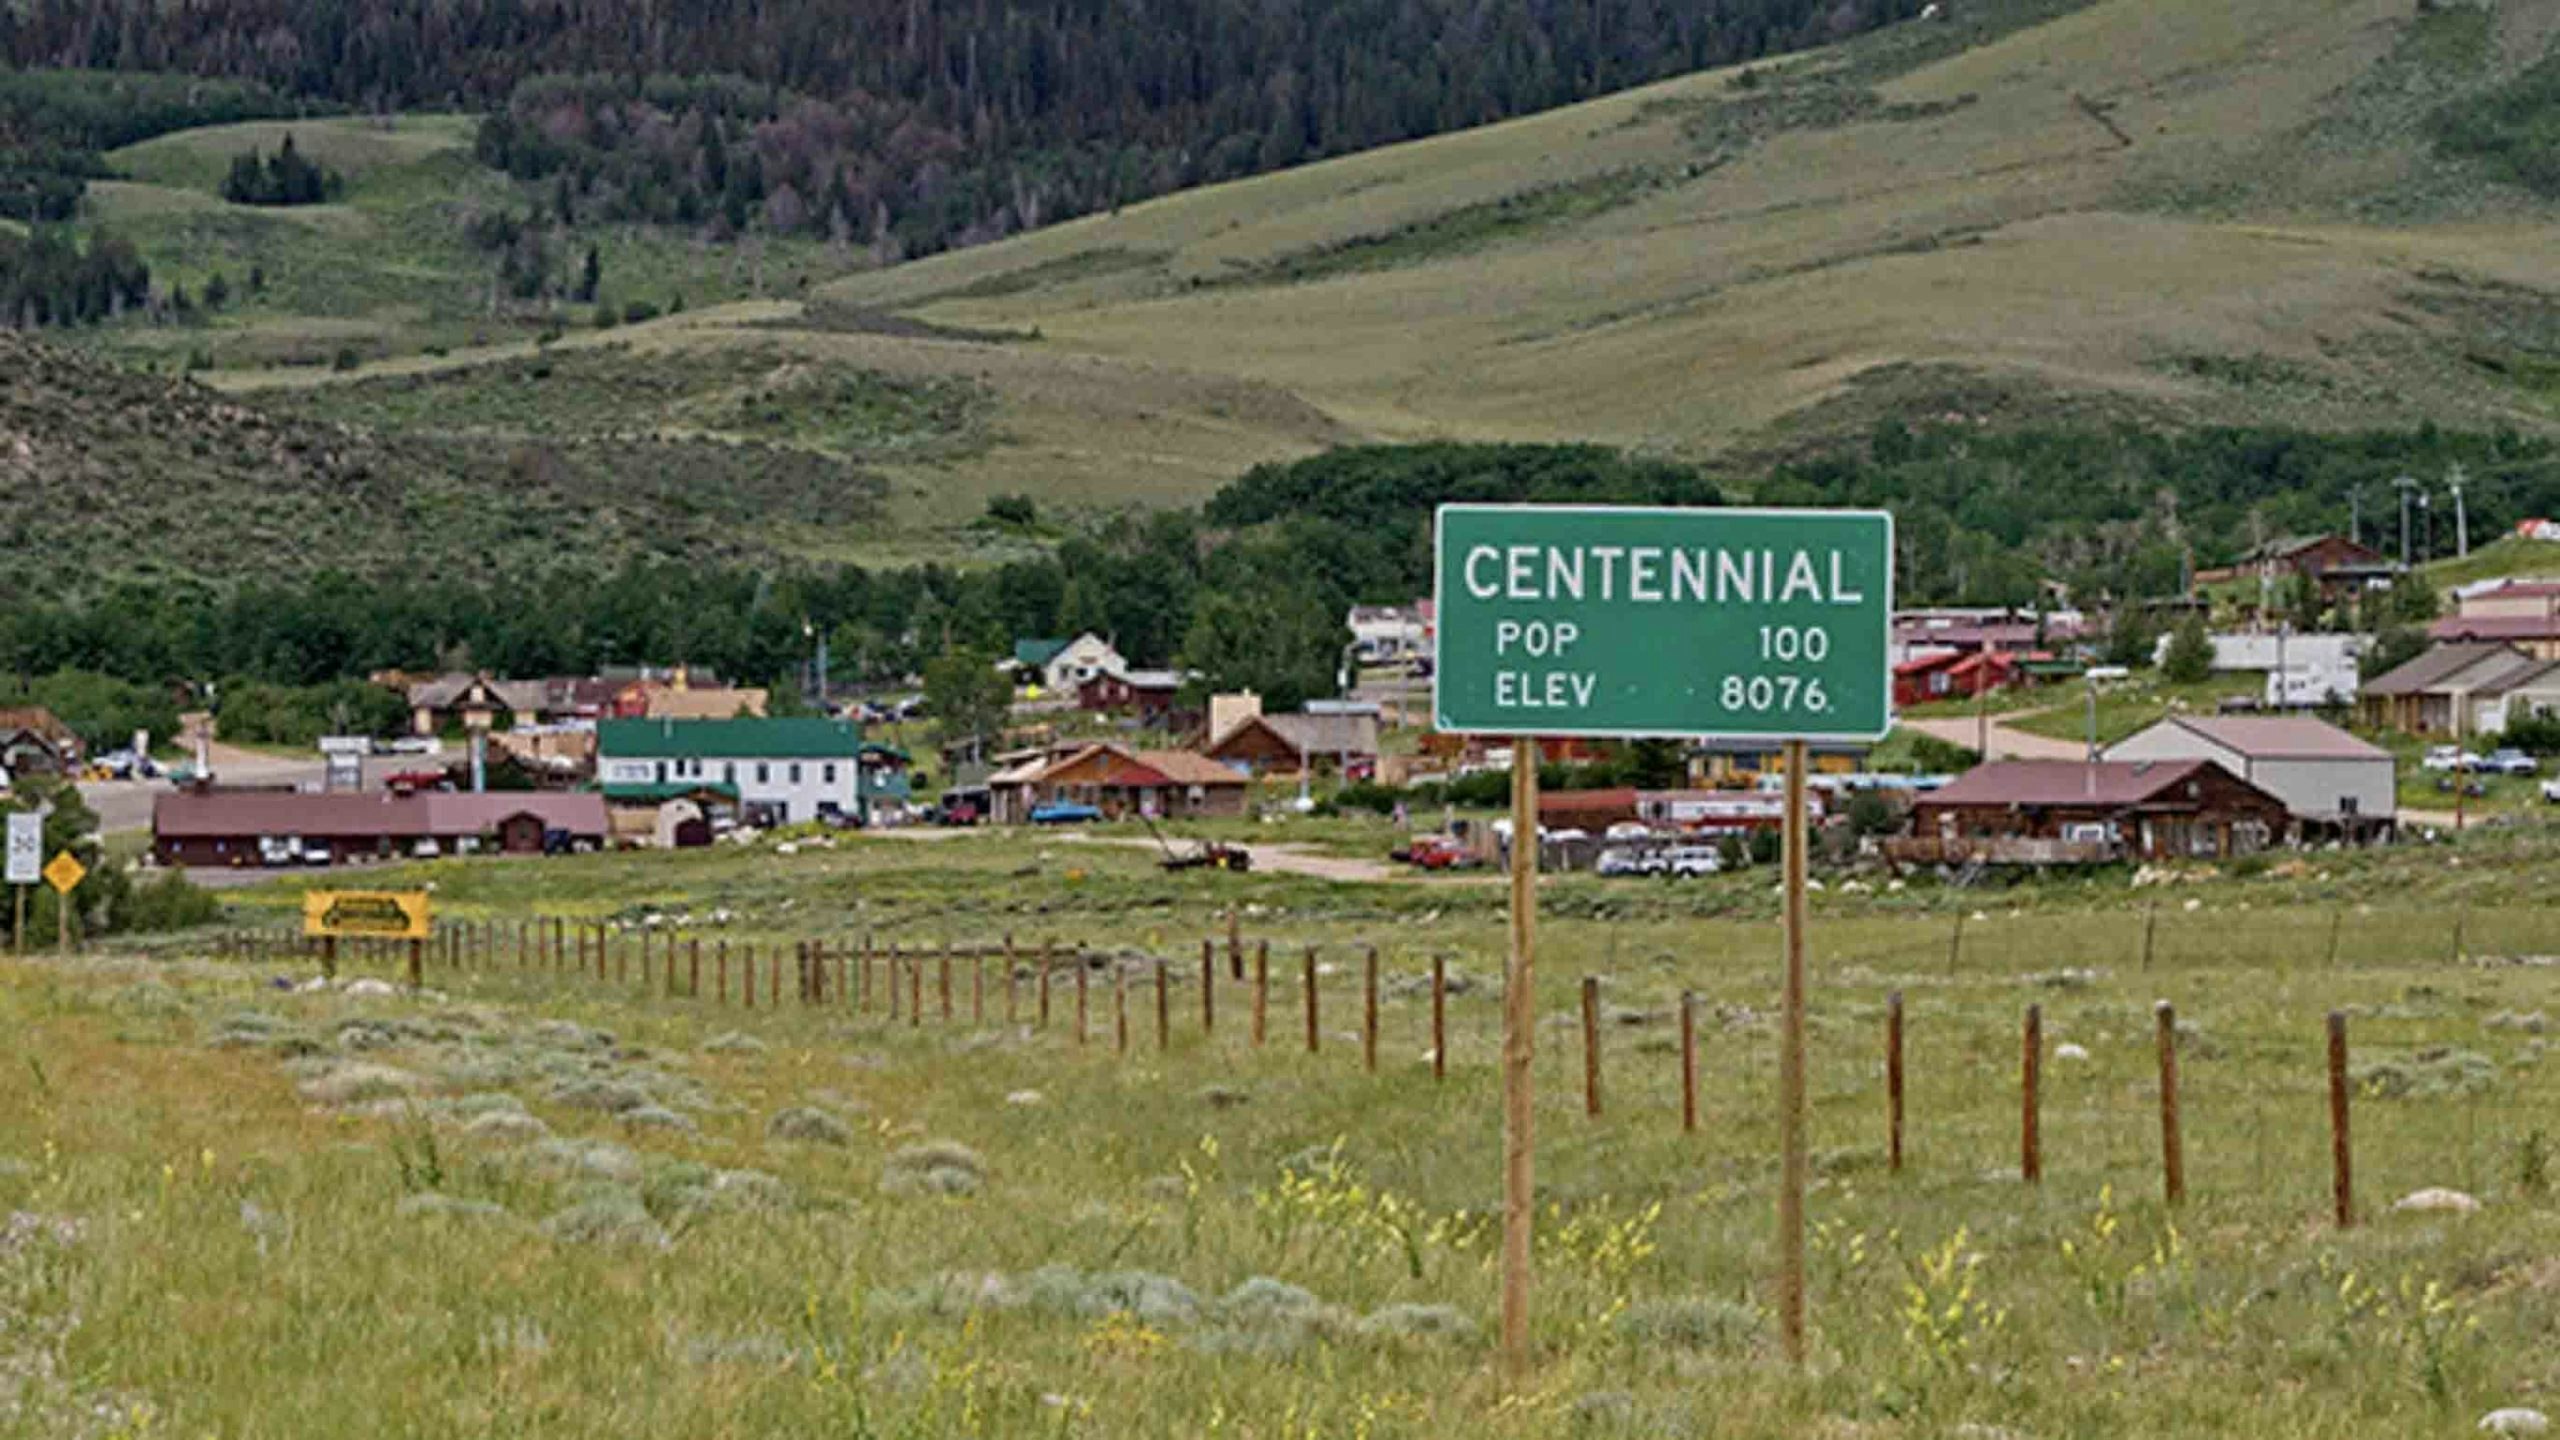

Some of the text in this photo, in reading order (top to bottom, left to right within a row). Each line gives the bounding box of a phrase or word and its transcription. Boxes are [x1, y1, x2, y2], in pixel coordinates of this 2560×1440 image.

[1464, 545, 1863, 603] CENTENNIAL
[1496, 622, 1828, 661] POP 100
[1495, 671, 1827, 711] ELEV 8076
